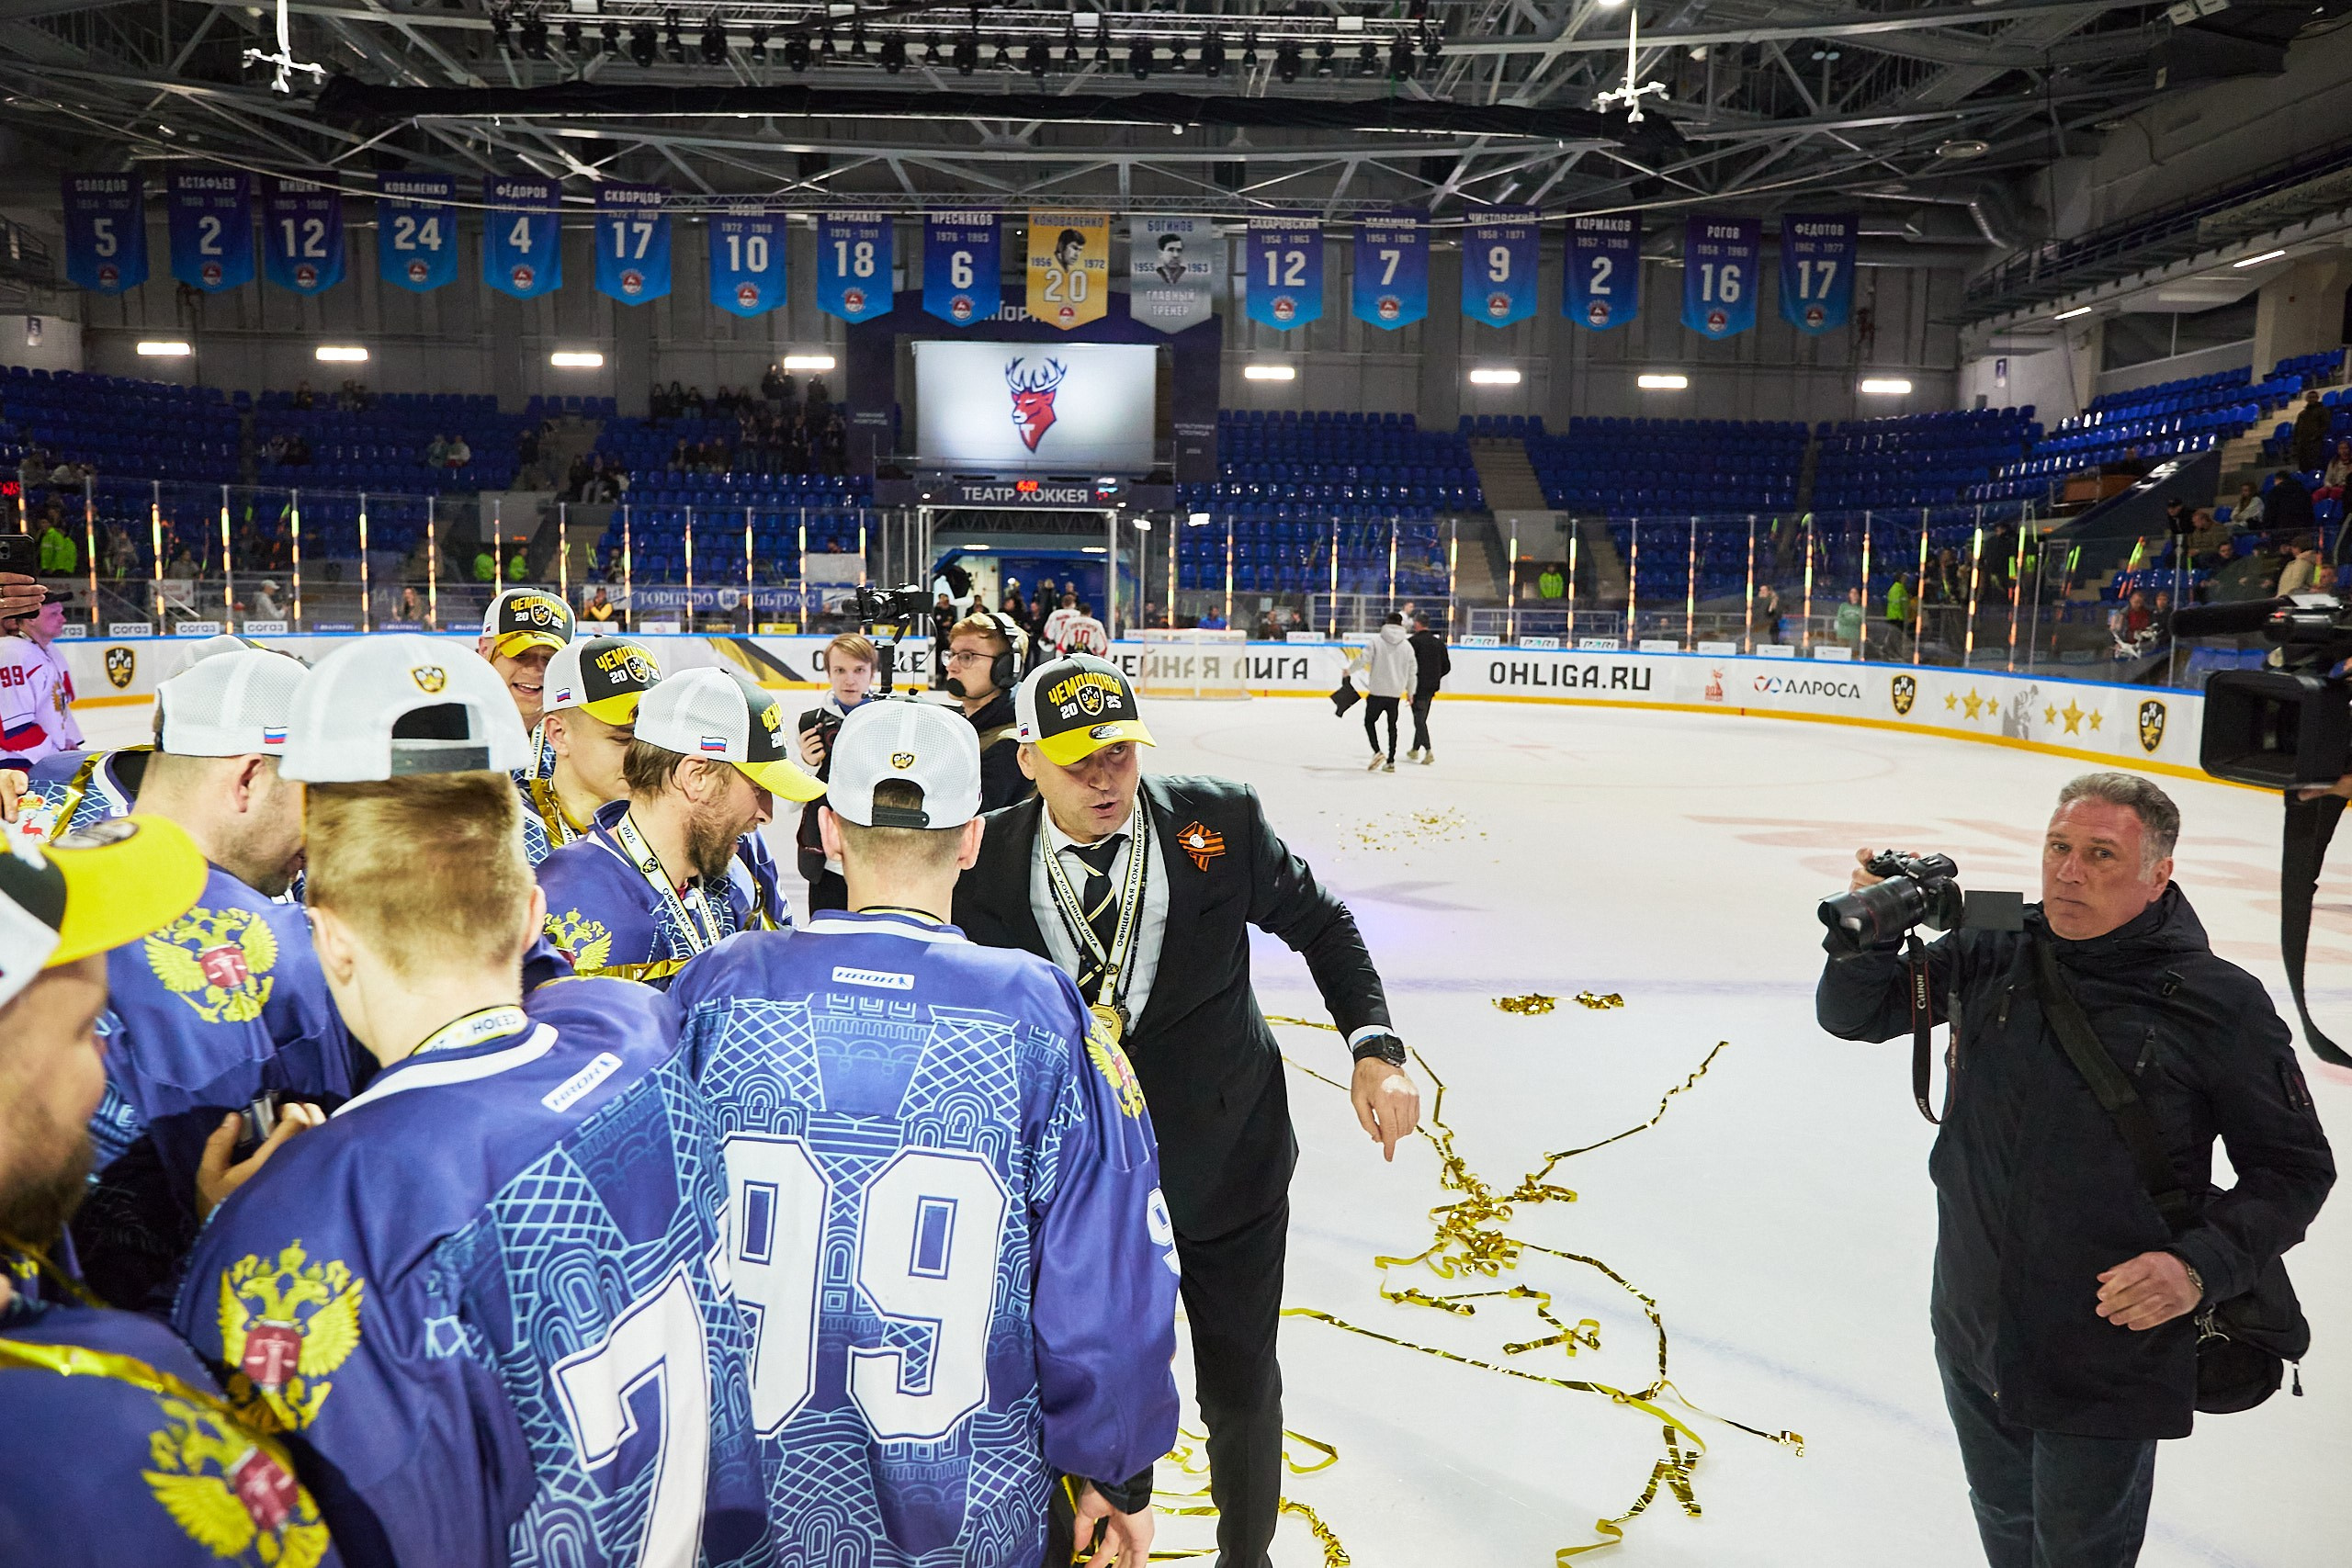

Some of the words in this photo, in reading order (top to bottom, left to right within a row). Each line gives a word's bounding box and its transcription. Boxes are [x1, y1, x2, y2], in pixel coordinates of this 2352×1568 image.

[178, 175, 236, 190] АСТАФЬЕВ
[384, 181, 447, 195] КОВАЛЕНКО
[496, 183, 548, 199] ФЁДОРОВ
[604, 189, 662, 204] СКВОРЦОВ
[931, 213, 993, 226] ПРЕСНЯКОВ
[1033, 215, 1104, 228] КОНОВАЛЕНКО
[1147, 220, 1193, 231] БОГИНОВ
[1249, 217, 1319, 230] САХАРОВСКИЙ
[1575, 218, 1632, 231] КОРМАКОВ
[1794, 222, 1845, 238] ФЕДОТОВ
[94, 218, 118, 257] 5
[198, 215, 223, 254] 2
[280, 218, 327, 258] 12
[394, 216, 443, 252] 24
[508, 217, 532, 254] 4
[612, 221, 653, 259] 17
[1707, 225, 1740, 240] РОГОВ
[727, 235, 768, 273] 10
[834, 241, 875, 278] 18
[1031, 257, 1053, 267] 1956
[1083, 258, 1105, 270] 1972
[1488, 246, 1510, 283] 9
[950, 251, 974, 289] 6
[1134, 262, 1155, 273] 1955
[1187, 263, 1208, 274] 1963
[1264, 250, 1306, 287] 12
[1379, 249, 1401, 286] 7
[1589, 256, 1613, 295] 2
[1043, 268, 1087, 303] 20
[1701, 263, 1742, 303] 16
[1798, 259, 1838, 300] 17
[1146, 288, 1195, 302] ГЛАВНЫЙ
[1151, 305, 1189, 316] ТРЕНЕР
[962, 486, 1015, 502] ТЕАТР
[1019, 487, 1089, 503] ХОККЕЯ
[510, 595, 567, 621] ЧЕМПИОНЫ
[514, 611, 530, 623] 20
[112, 625, 148, 635] согаз
[180, 624, 216, 634] согаз
[247, 623, 284, 632] согаз
[1075, 629, 1090, 645] 10
[1464, 637, 1499, 648] PARI
[1522, 638, 1555, 649] PARI
[1583, 640, 1615, 649] PARI
[595, 645, 659, 672] ЧЕМПИОНЫ
[1233, 655, 1308, 680] ЛИГА
[0, 665, 25, 687] 99
[609, 669, 628, 684] 20
[1489, 660, 1651, 691] OHLIGA.RU
[1047, 671, 1125, 706] ЧЕМПИОНЫ
[1784, 679, 1861, 699] АЛРОСА
[1060, 702, 1079, 720] 20
[1106, 694, 1123, 710] 25
[622, 824, 637, 844] 2025
[1116, 887, 1136, 948] ОФИЦЕРСКАЯ
[1130, 833, 1143, 886] ХОККЕЙНАЯ
[662, 887, 699, 946] ОФИЦЕРСКАЯ
[1058, 878, 1086, 933] ХОККЕЙНАЯ
[1083, 928, 1099, 950] ЛИГА
[1916, 974, 1926, 1010] Canon
[723, 1129, 1013, 1446] 99
